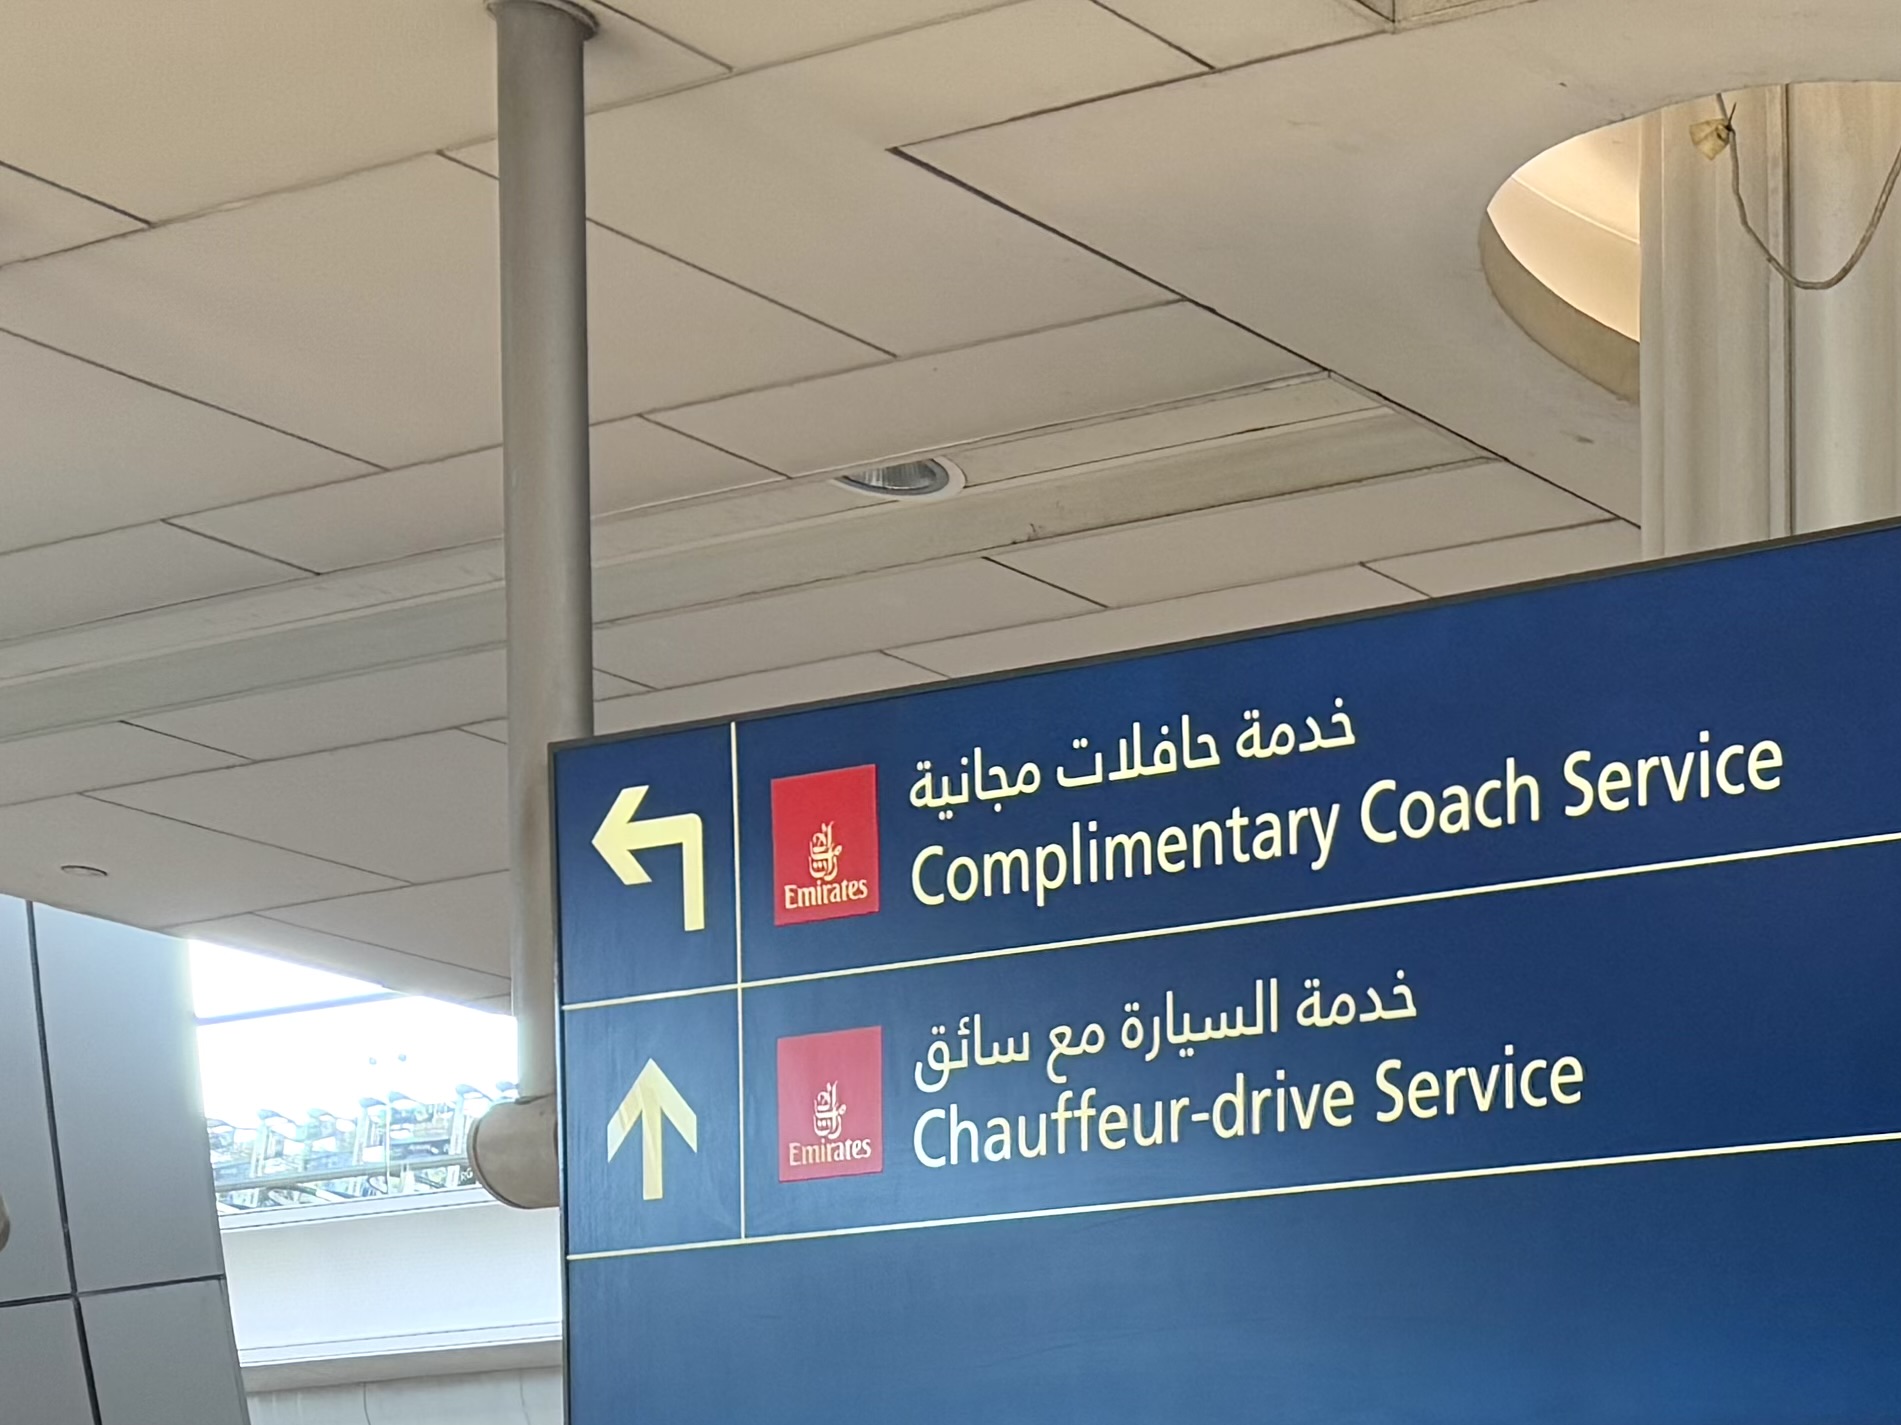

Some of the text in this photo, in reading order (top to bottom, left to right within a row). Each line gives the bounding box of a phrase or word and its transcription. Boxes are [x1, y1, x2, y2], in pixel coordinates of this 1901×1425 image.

[908, 697, 1356, 820] خدمة حافلات مجانية
[911, 730, 1784, 907] Complimentary Coach Service
[784, 877, 869, 910] Emirates
[913, 969, 1418, 1093] خدمة السيارة مع سائق
[788, 1137, 872, 1168] Emirates
[913, 1043, 1585, 1169] Chauffeur-drive Service
